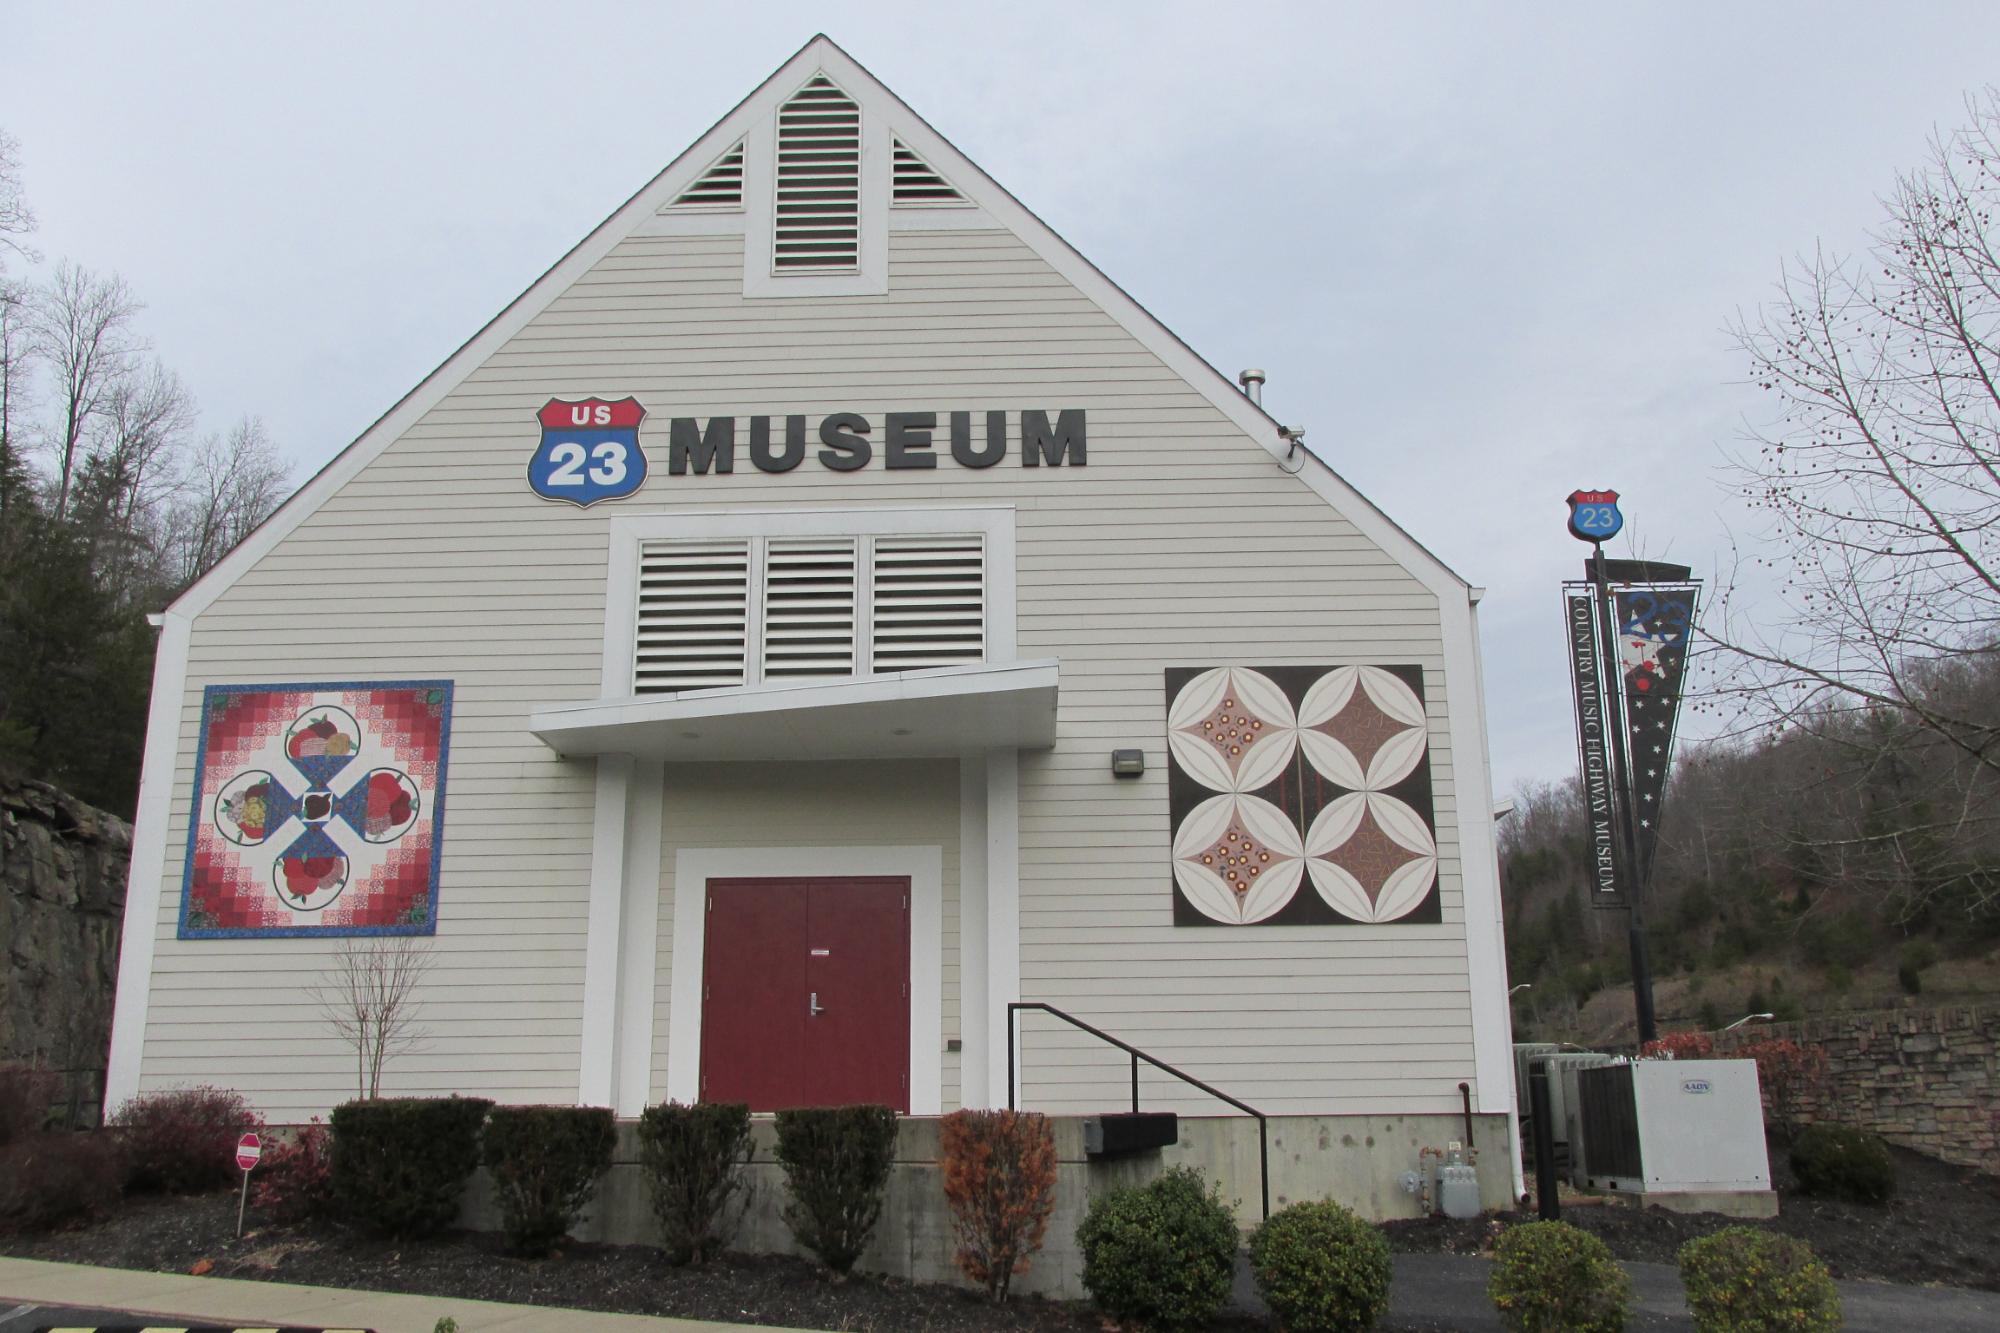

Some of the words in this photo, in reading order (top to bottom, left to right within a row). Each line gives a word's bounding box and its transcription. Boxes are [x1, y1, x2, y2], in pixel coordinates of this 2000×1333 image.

[571, 406, 612, 426] US
[668, 408, 1087, 476] MUSEUM
[547, 442, 628, 486] 23
[1582, 507, 1614, 528] 23
[1586, 494, 1604, 503] US
[1573, 597, 1595, 676] COUNTRY
[1580, 681, 1600, 733] MUSIC
[1586, 738, 1609, 815] HIGHWAY
[1594, 820, 1616, 893] MUSEUM
